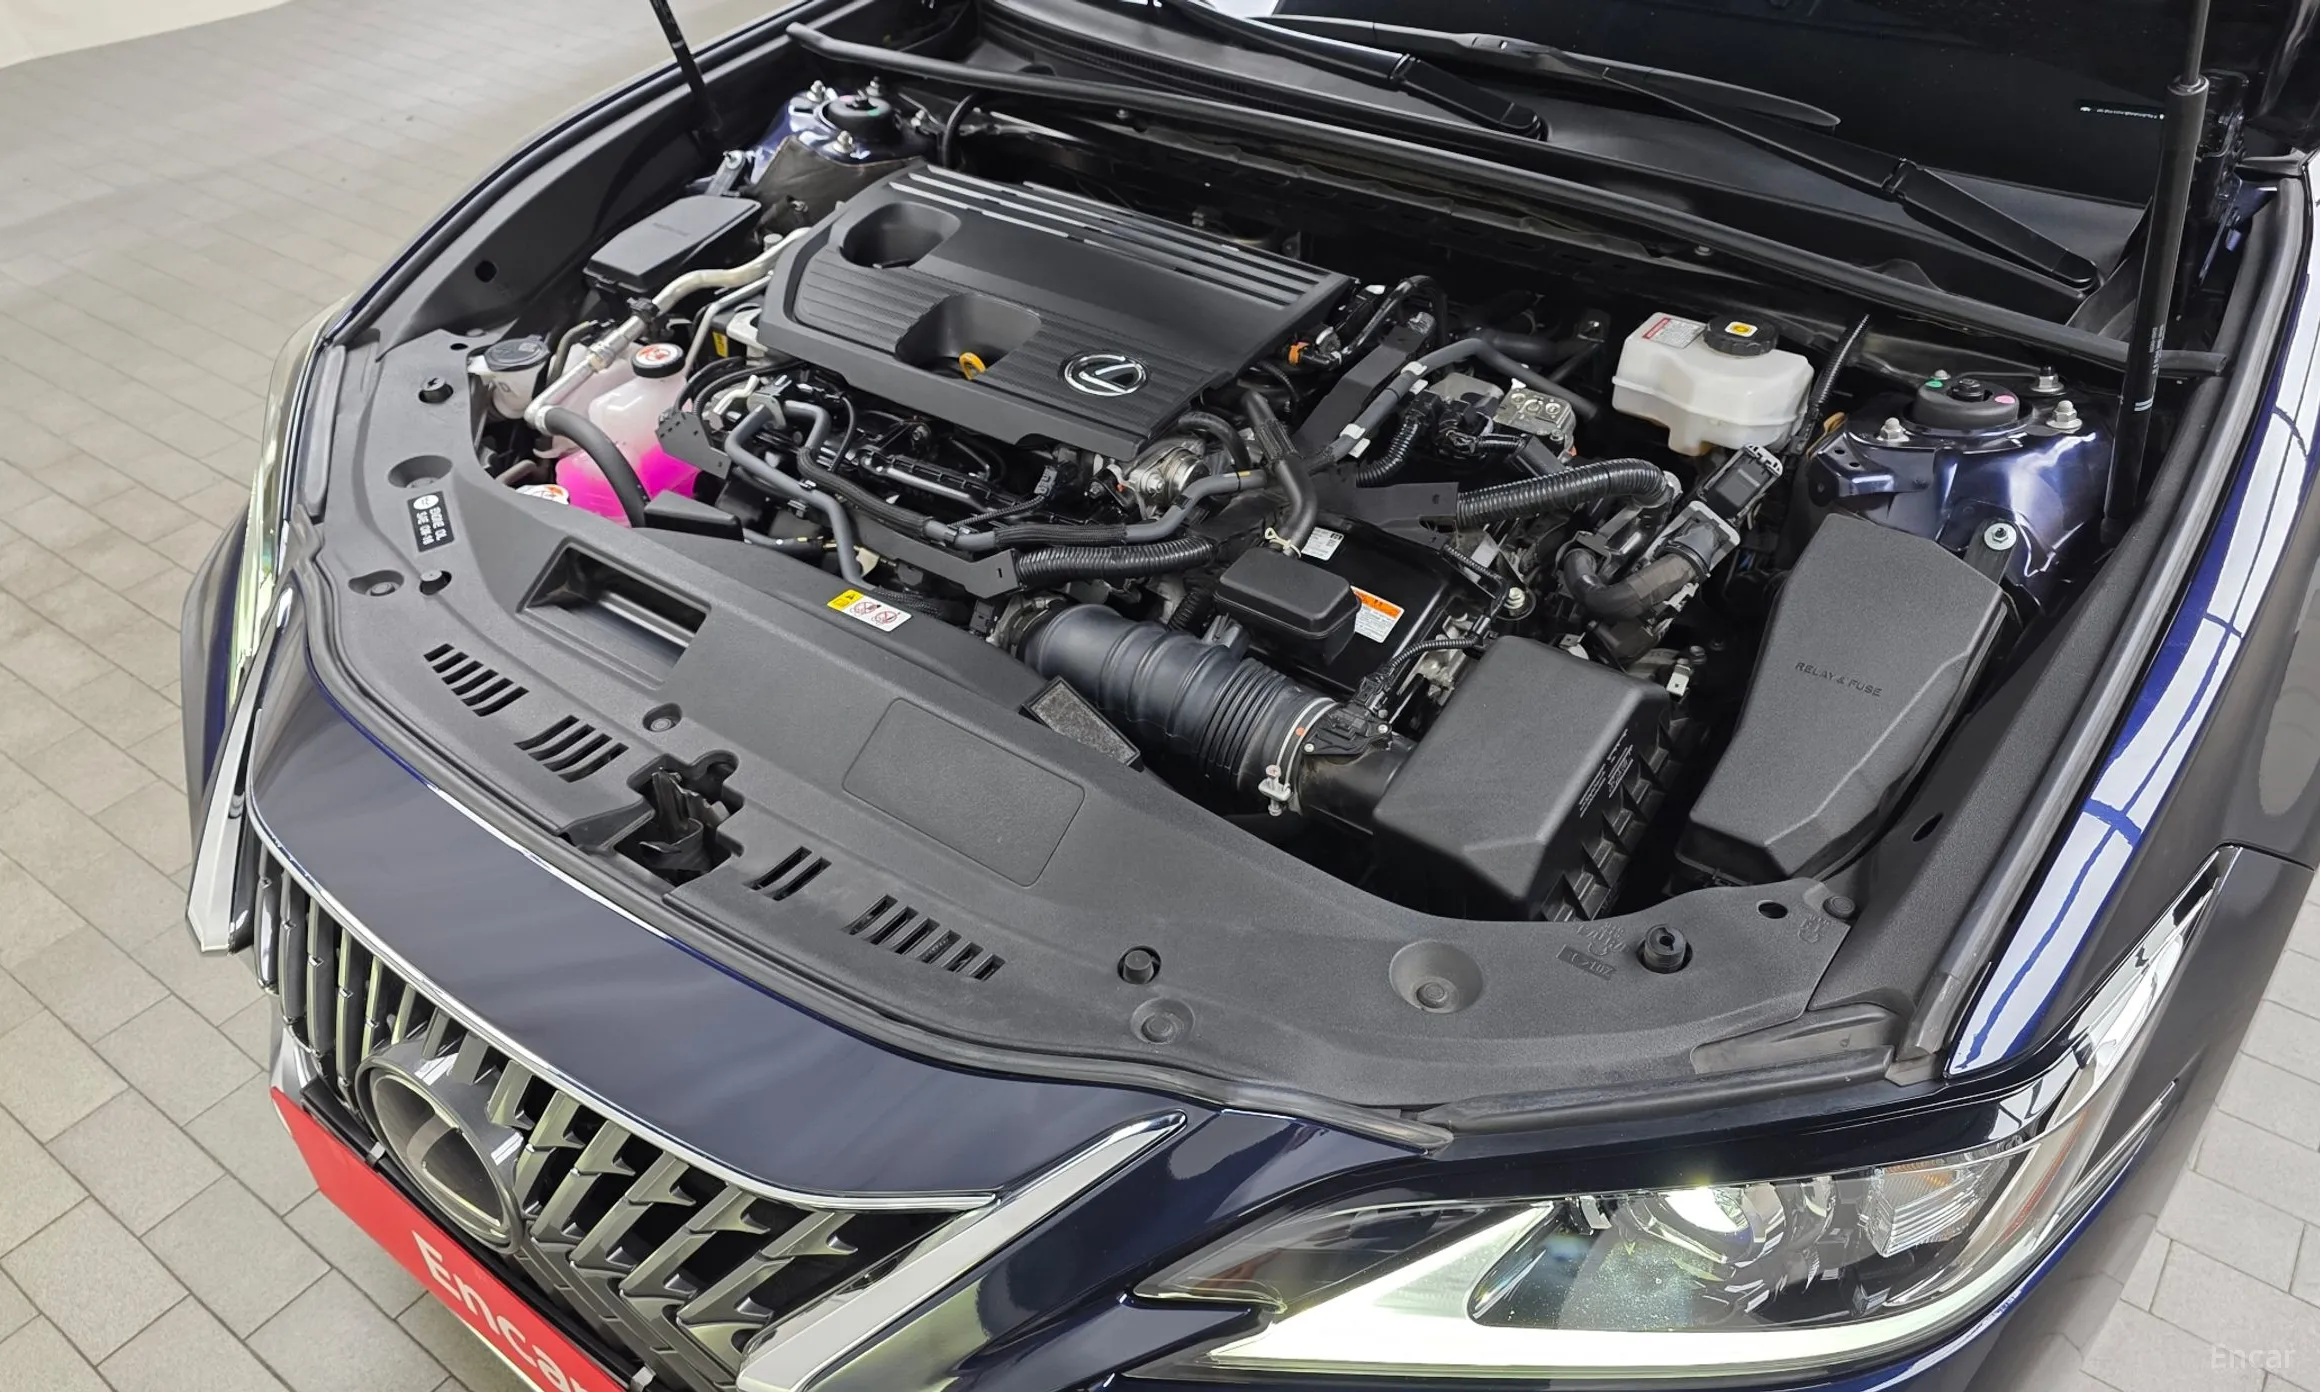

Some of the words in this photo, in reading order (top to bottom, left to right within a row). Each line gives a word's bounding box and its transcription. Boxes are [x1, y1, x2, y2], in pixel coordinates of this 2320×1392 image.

[1795, 662, 1836, 681] RELAY
[1836, 676, 1845, 685] &
[1848, 679, 1883, 697] FUSE
